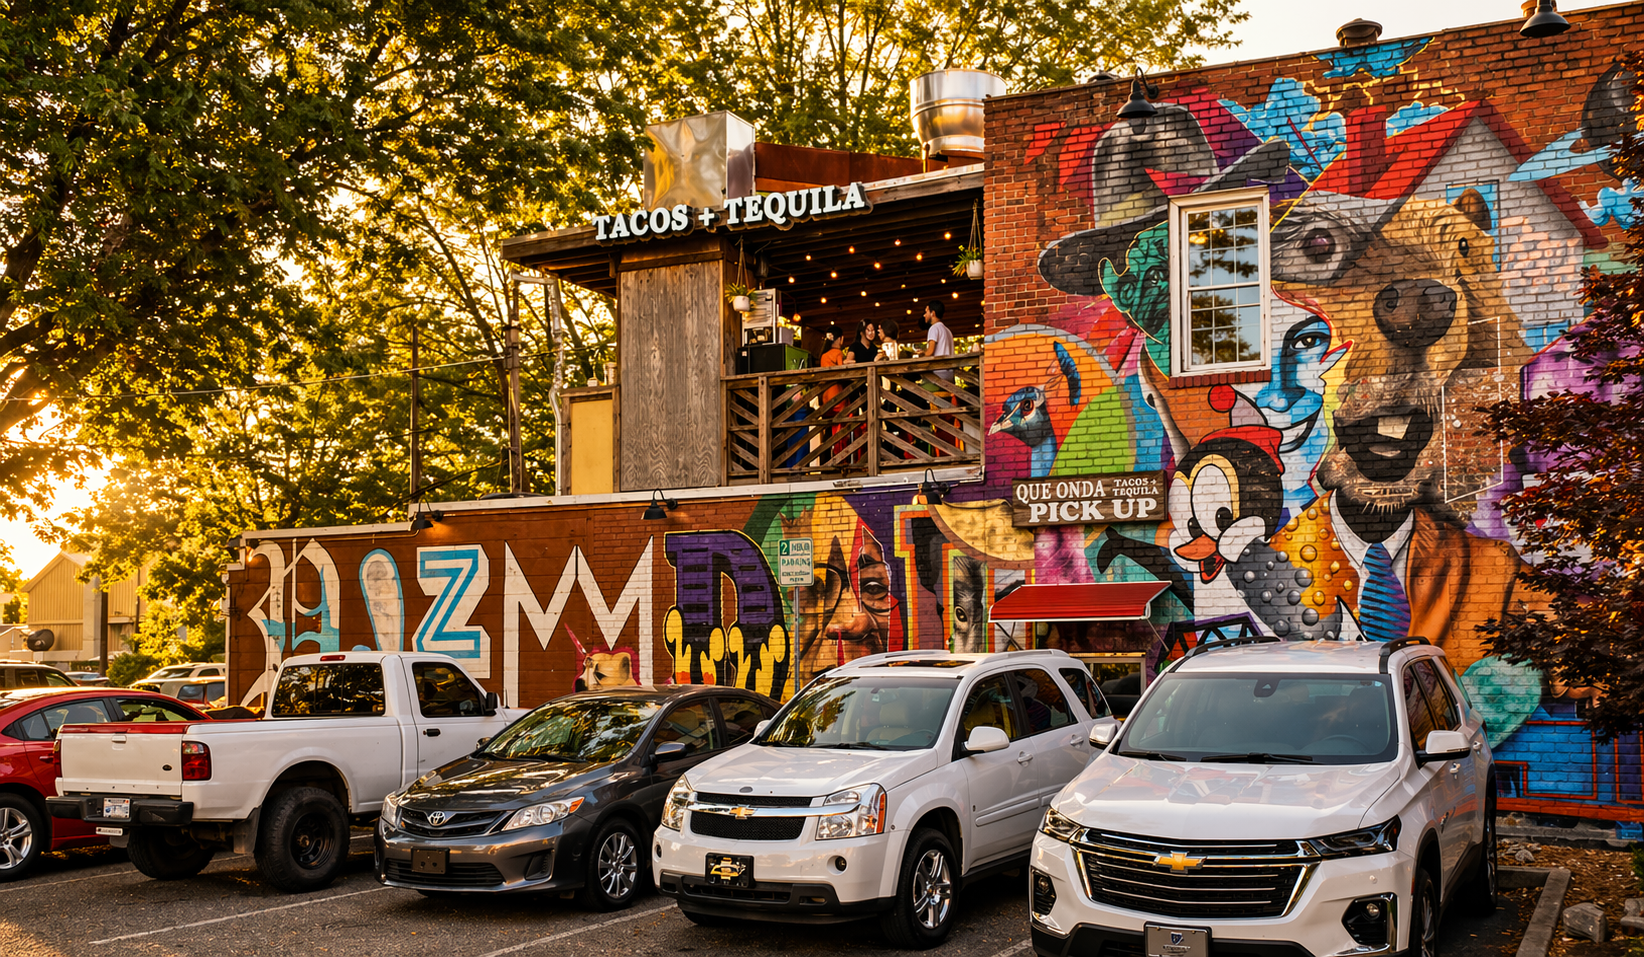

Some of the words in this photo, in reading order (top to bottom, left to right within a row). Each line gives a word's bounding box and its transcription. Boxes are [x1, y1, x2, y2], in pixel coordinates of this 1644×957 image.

[592, 204, 690, 240] TACOS
[698, 207, 715, 227] +
[723, 182, 865, 226] TEQUILA
[1016, 483, 1051, 504] QUE
[1056, 480, 1106, 499] ONDA
[1113, 478, 1149, 487] TACOS
[1112, 487, 1159, 498] TEQUILA
[1028, 500, 1105, 523] PICK
[1111, 498, 1157, 519] UP
[781, 541, 788, 555] 2
